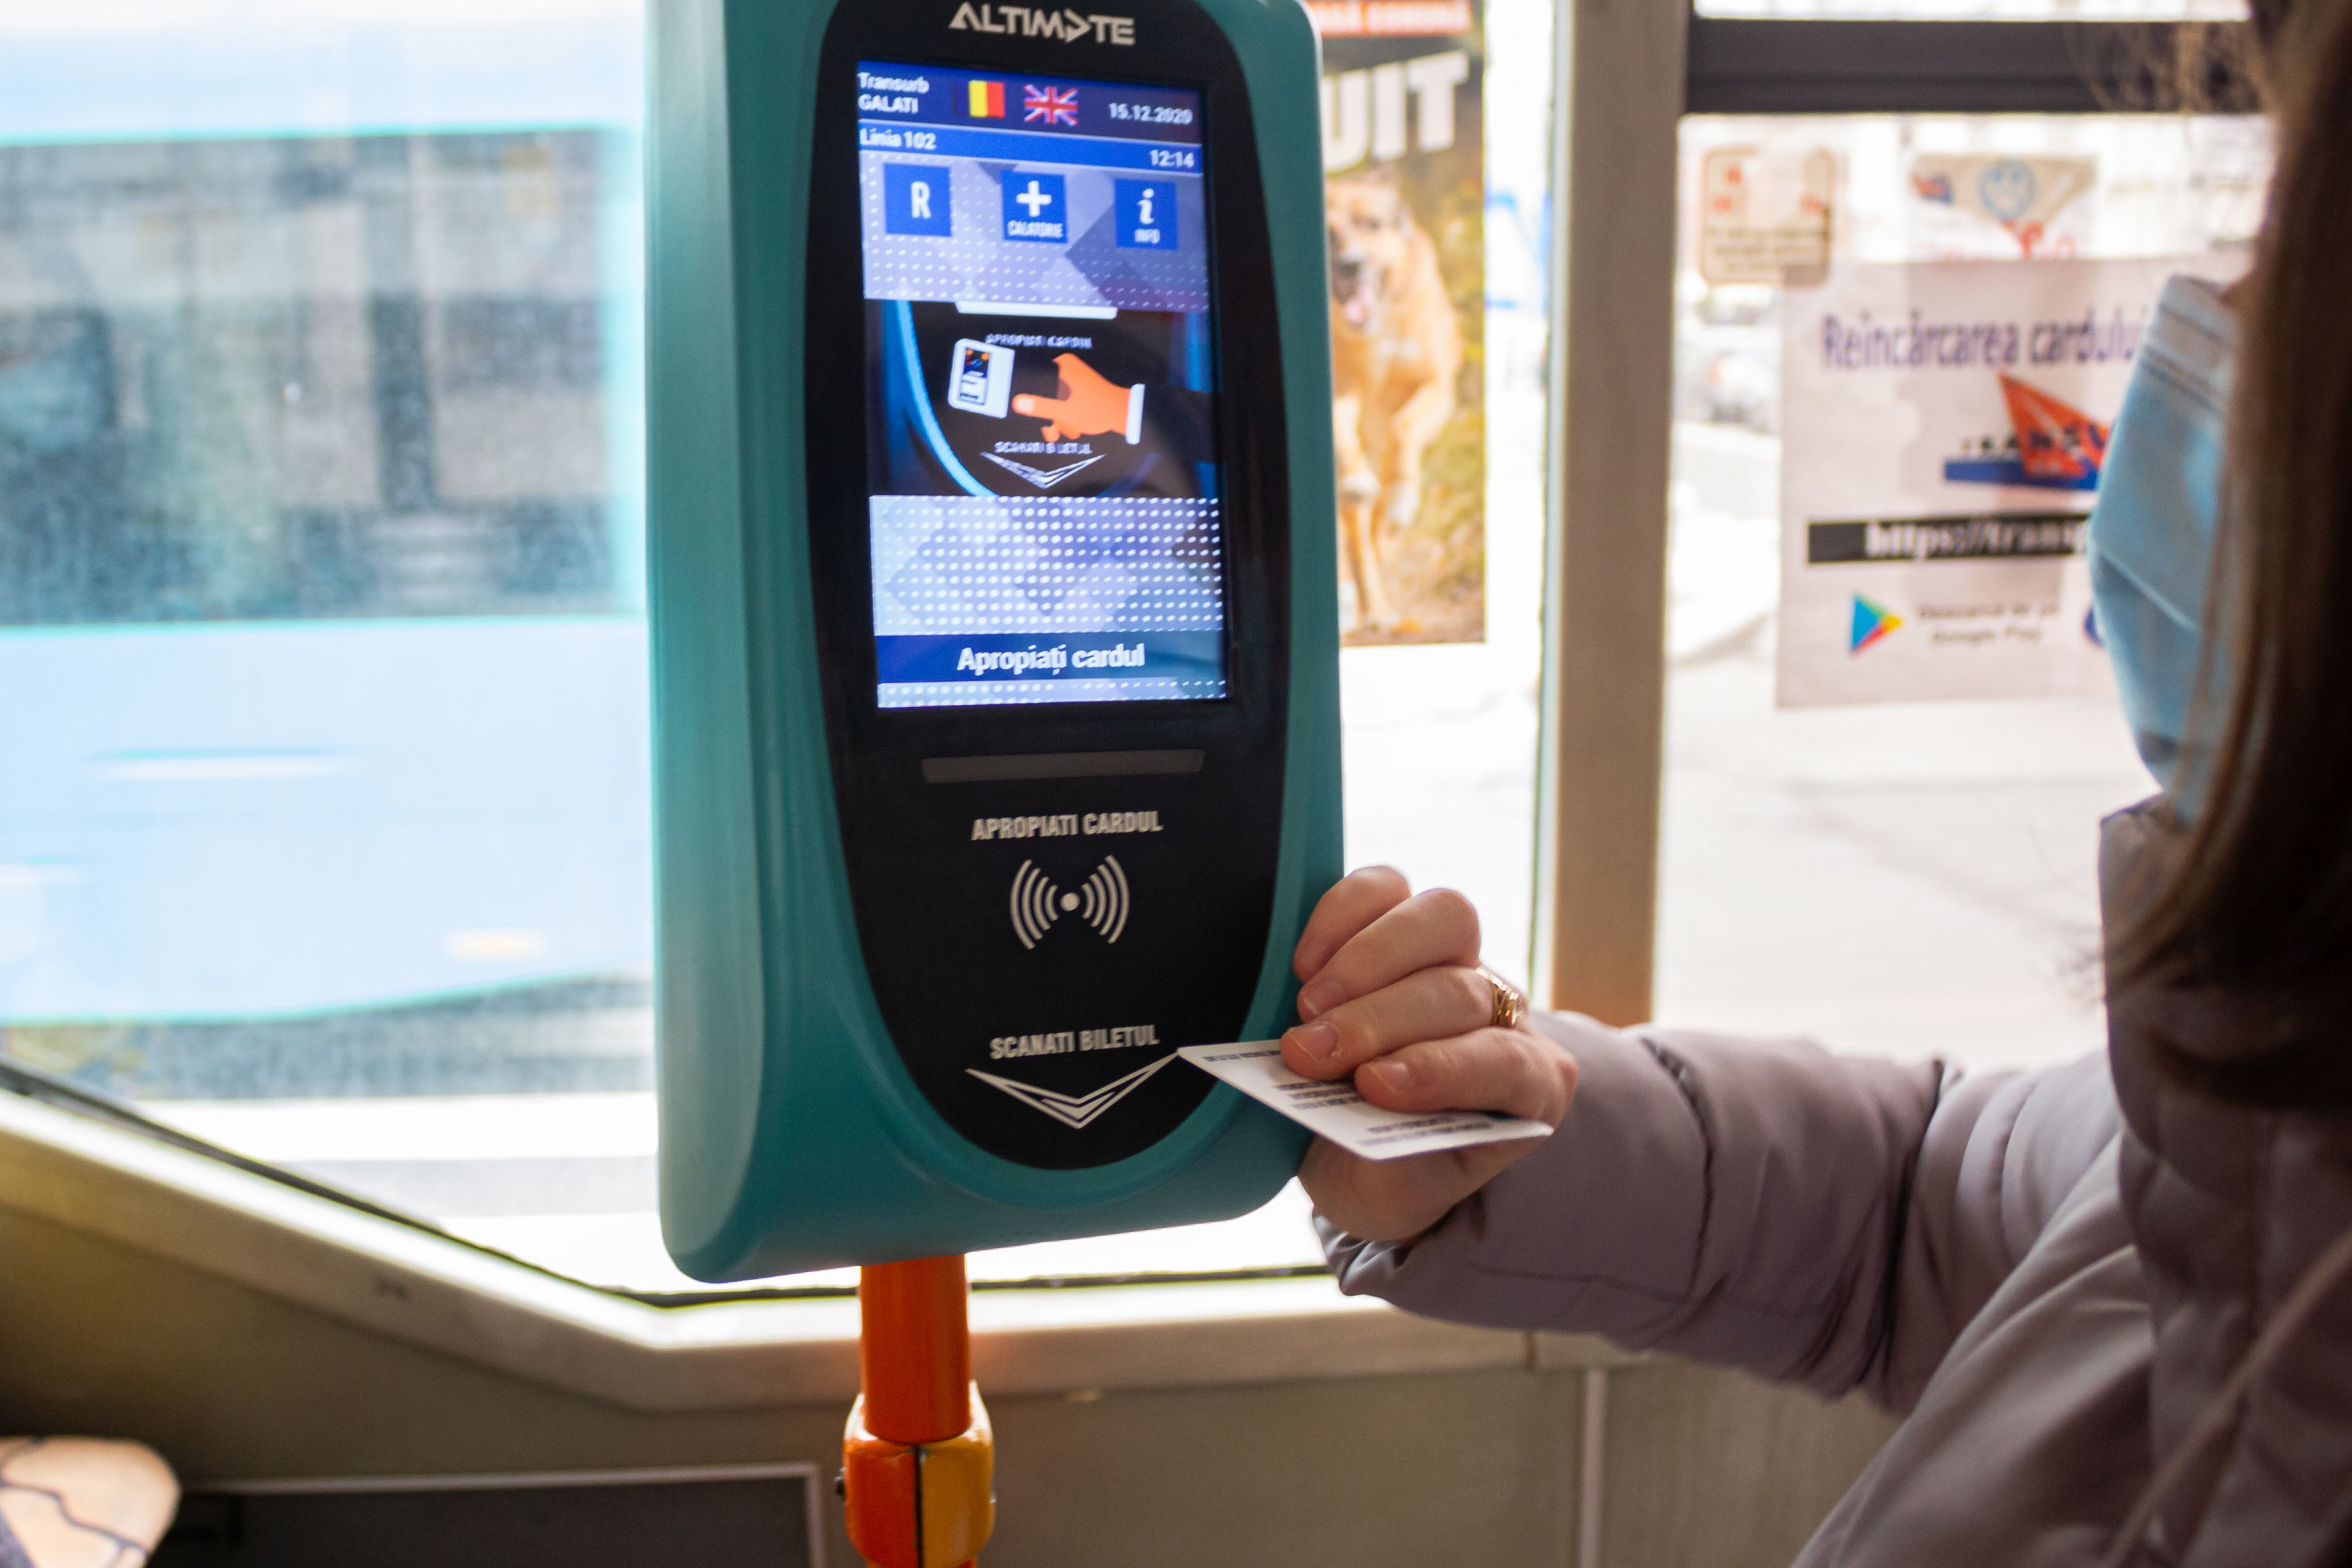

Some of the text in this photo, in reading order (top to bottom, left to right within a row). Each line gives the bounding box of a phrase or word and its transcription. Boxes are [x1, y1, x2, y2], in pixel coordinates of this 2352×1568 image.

[858, 94, 919, 114] GALATI
[859, 127, 937, 150] Linia 102
[911, 181, 932, 219] R
[1071, 643, 1145, 668] cardul
[971, 811, 1163, 840] APROPIATI CARDUL
[990, 1025, 1160, 1059] SCANATI BILETUL
